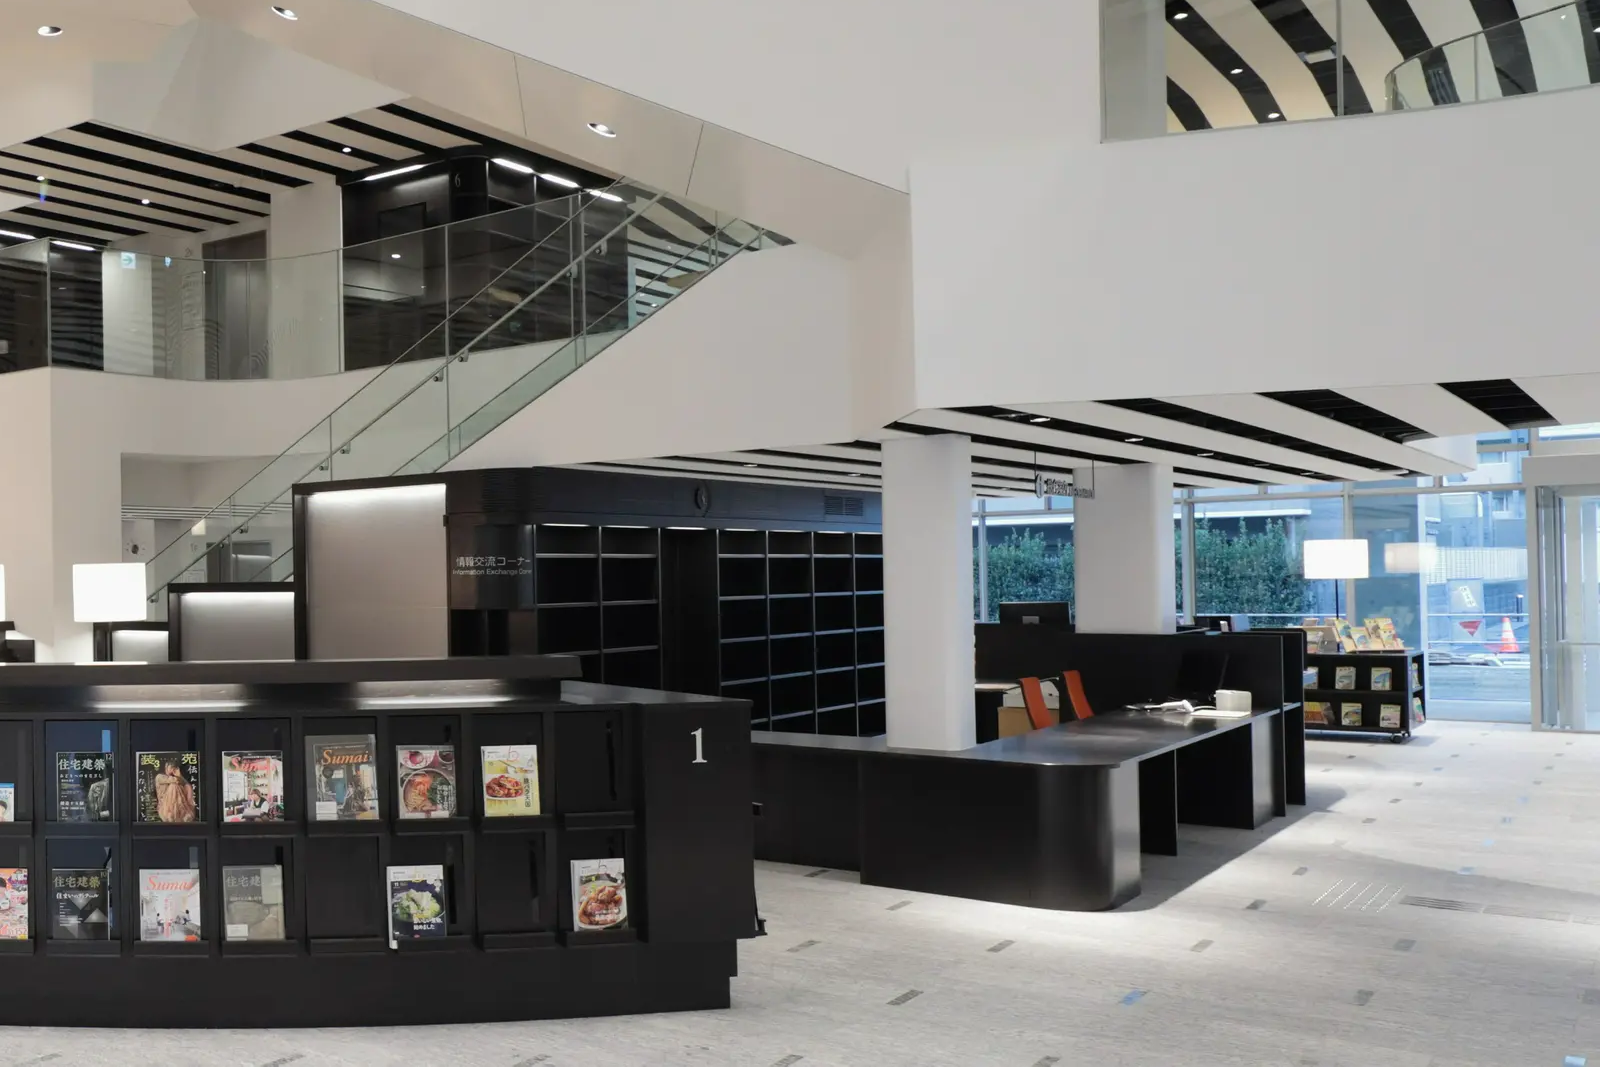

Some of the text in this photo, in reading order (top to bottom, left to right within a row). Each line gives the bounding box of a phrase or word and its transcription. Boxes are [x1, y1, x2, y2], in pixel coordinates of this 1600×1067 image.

[454, 173, 461, 188] 6
[456, 556, 532, 568] 情報交流コーナー
[691, 727, 707, 764] 1
[58, 758, 106, 771] 住宅建築
[321, 749, 370, 766] Sumai
[53, 875, 101, 889] 住宅建築
